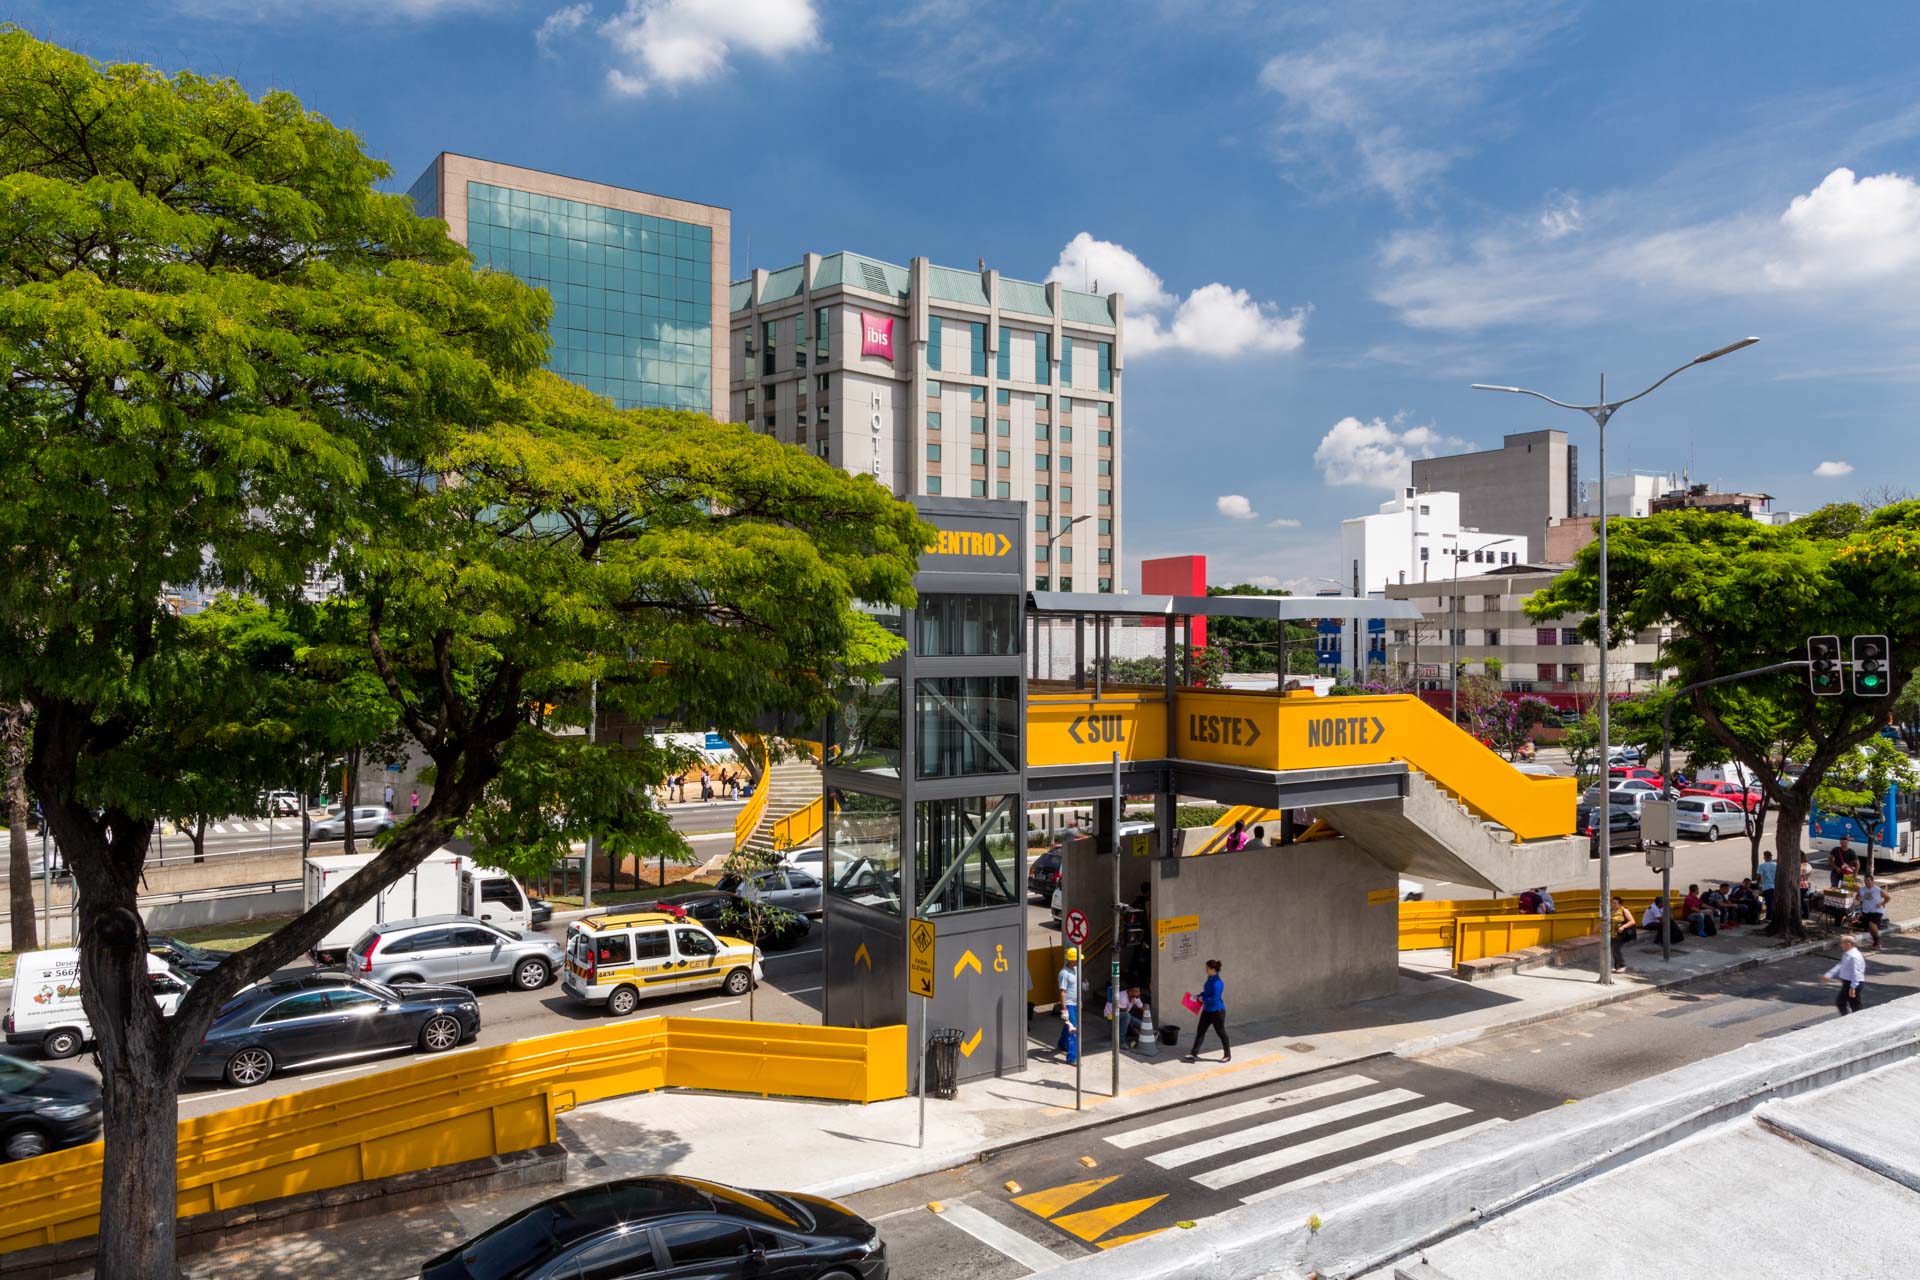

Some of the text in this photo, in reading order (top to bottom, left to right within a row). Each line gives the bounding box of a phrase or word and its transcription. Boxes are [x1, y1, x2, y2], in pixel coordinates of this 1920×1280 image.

[867, 326, 888, 346] ibis
[871, 391, 882, 475] HOTE
[1088, 715, 1125, 743] SUL
[1189, 714, 1242, 745] LESTE
[1308, 717, 1368, 747] NORTE
[689, 959, 705, 968] CET
